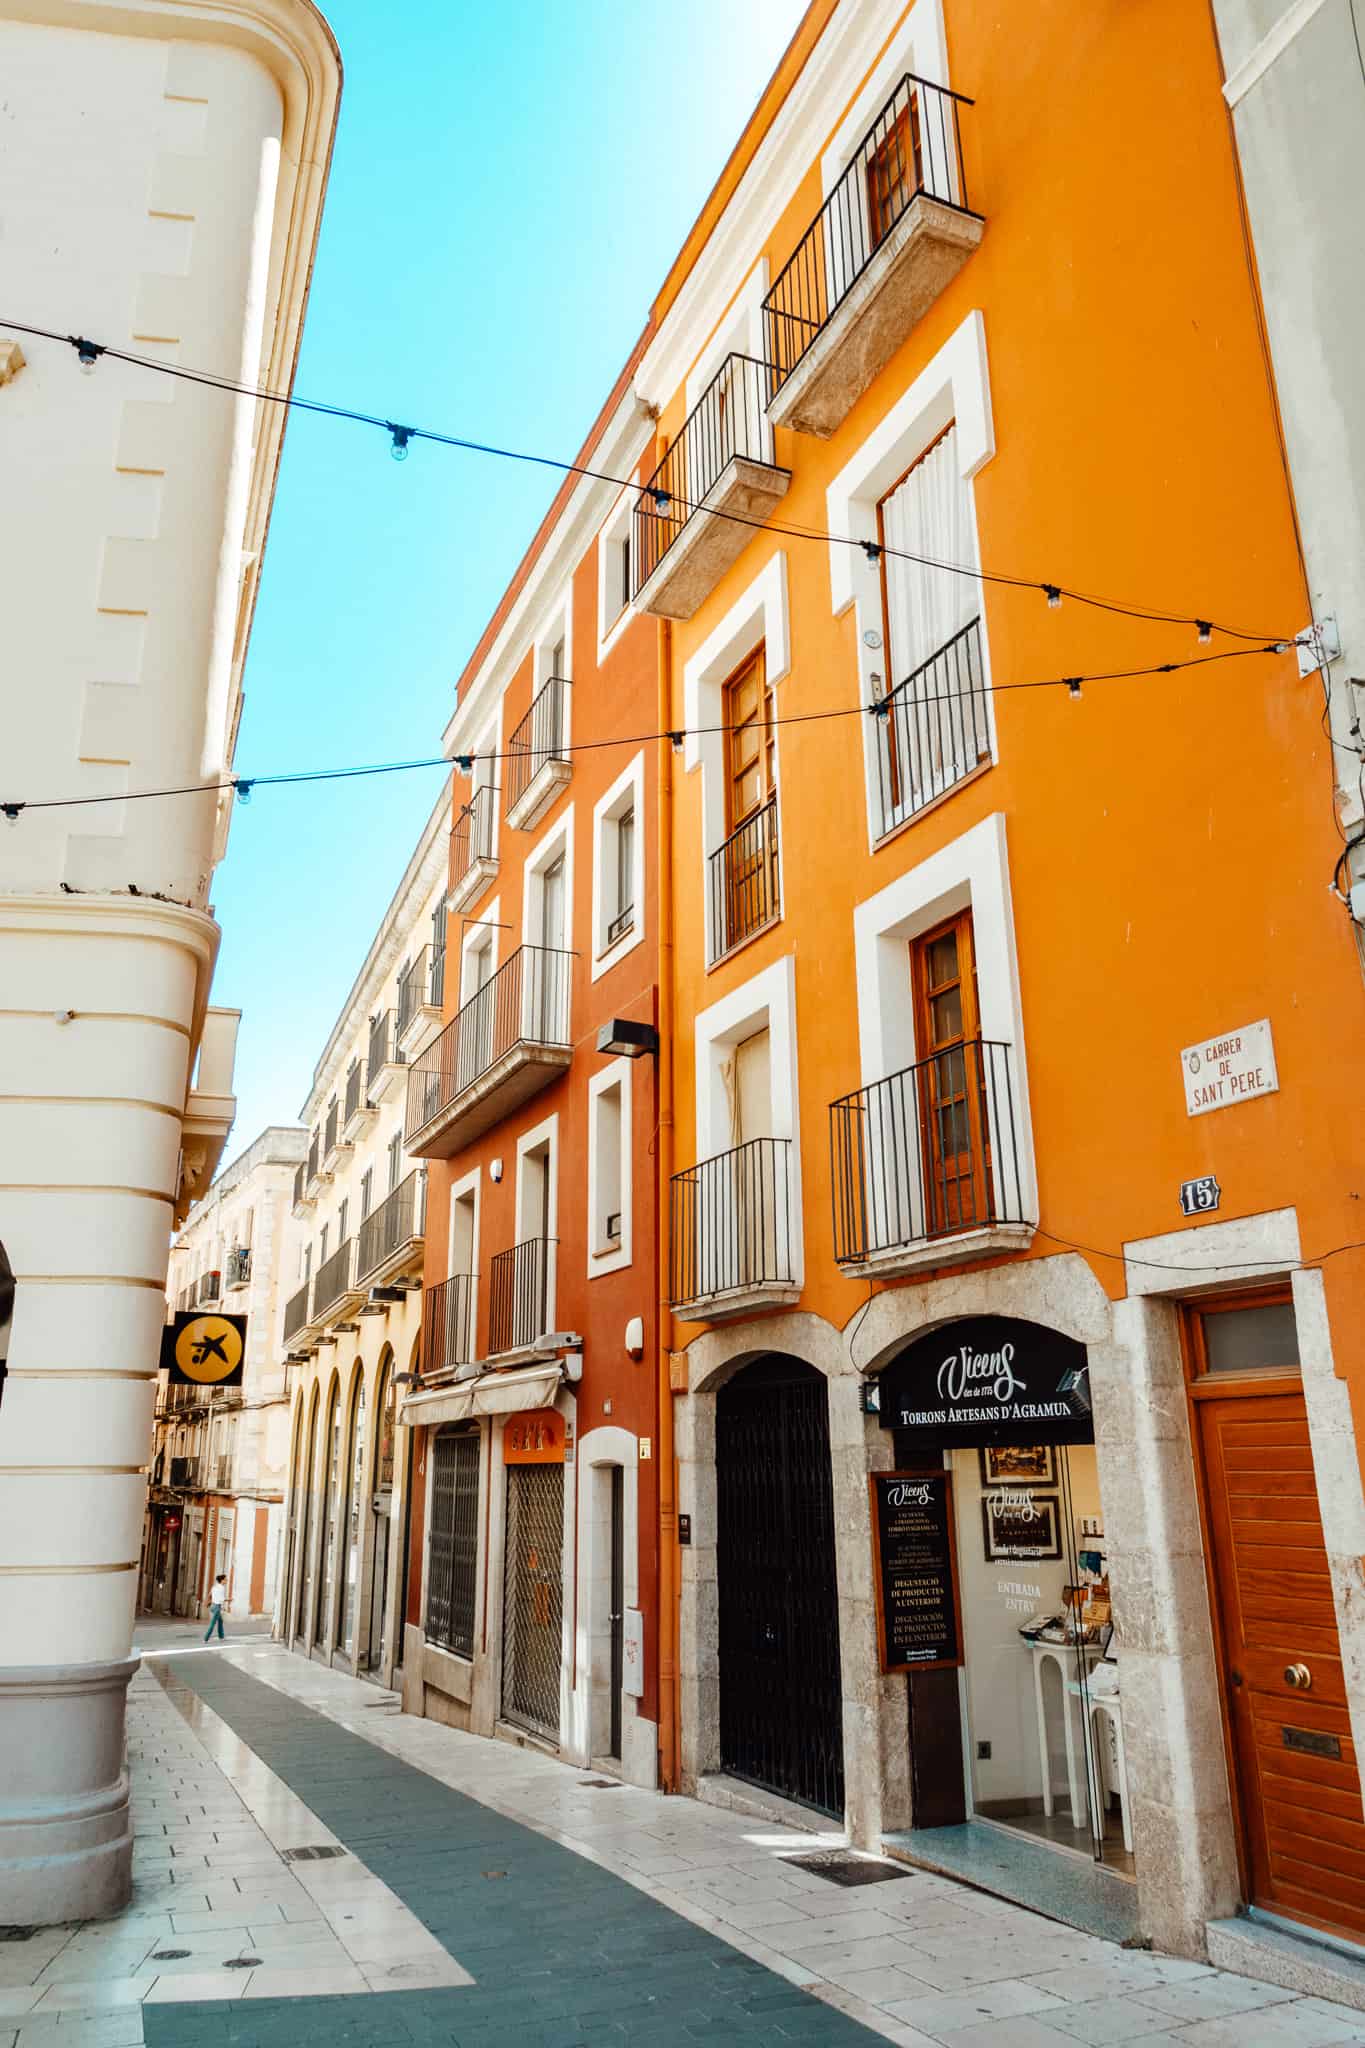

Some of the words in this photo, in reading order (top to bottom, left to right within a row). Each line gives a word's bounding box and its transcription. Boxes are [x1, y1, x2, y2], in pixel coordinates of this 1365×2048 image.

[1205, 1037, 1242, 1062] CARRER
[1219, 1060, 1232, 1077] DE
[1193, 1081, 1224, 1107] SANT
[1230, 1068, 1265, 1096] PERE
[1184, 1181, 1213, 1211] 15
[937, 1343, 1027, 1401] Vicens
[901, 1410, 946, 1425] TORRONS
[948, 1407, 999, 1423] ARTESANS
[1001, 1402, 1071, 1420] D'AGRAMUN
[887, 1484, 935, 1505] Vicens
[997, 1581, 1040, 1598] ENTRADA
